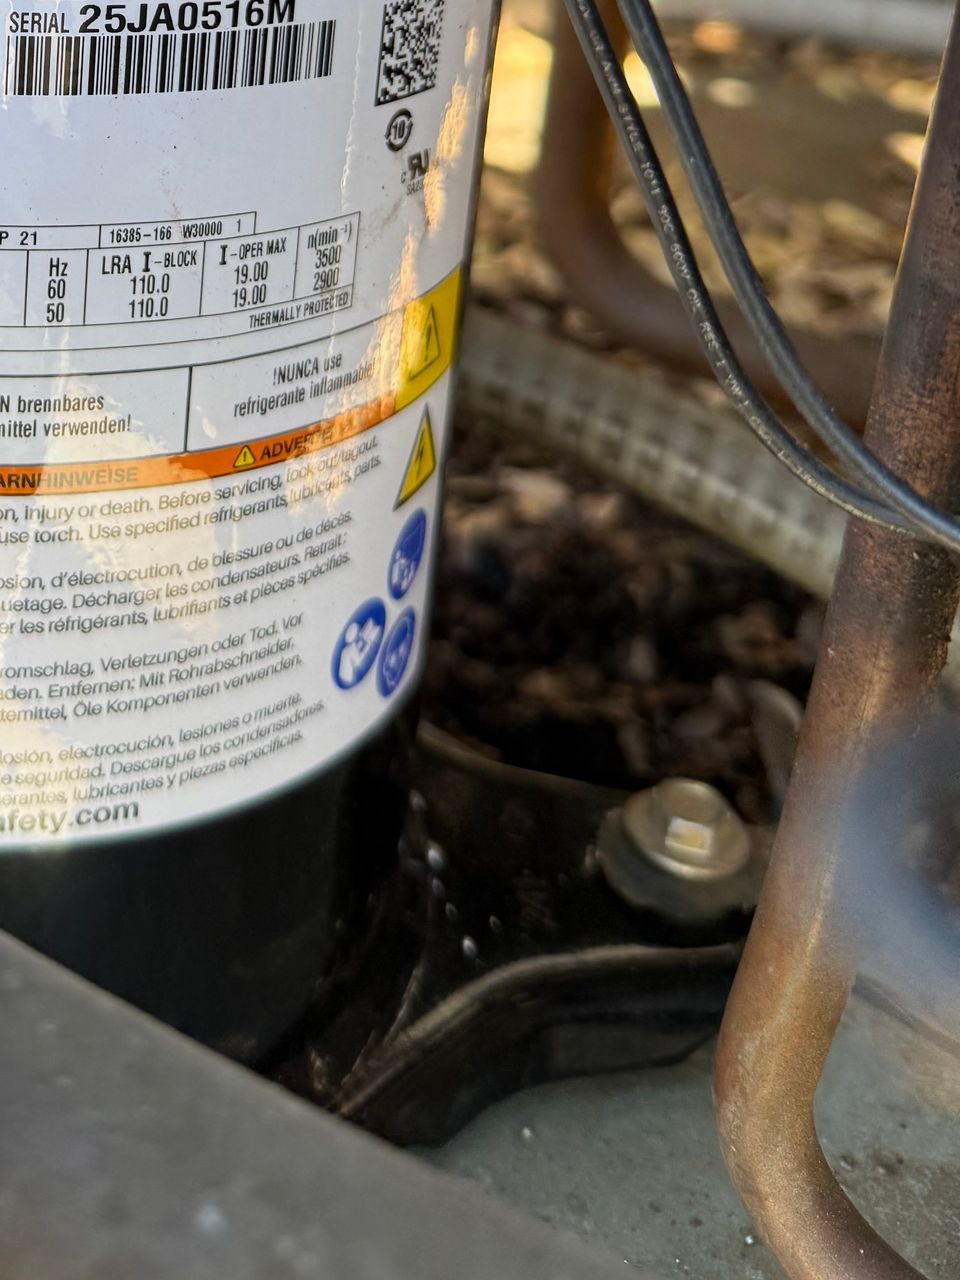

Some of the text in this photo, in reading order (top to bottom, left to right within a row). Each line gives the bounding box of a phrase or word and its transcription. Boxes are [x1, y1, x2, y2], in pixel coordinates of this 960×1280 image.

[9, 12, 69, 34] SERIAL
[20, 231, 37, 246] 21
[49, 257, 68, 277] Hz
[102, 237, 287, 275] LRA MAX
[130, 244, 341, 295] 110.0 19.00 3500
[47, 279, 66, 299] 60
[129, 266, 340, 319] 110.0 19.00 2900
[46, 302, 65, 323] 50
[249, 291, 348, 329] THERMALLY PROTECTED
[324, 353, 342, 370] use
[18, 394, 104, 413] brennbares
[234, 388, 305, 418] refrigerante
[44, 415, 131, 438] verwenden!
[24, 504, 74, 524] injury
[100, 493, 153, 516] death.
[158, 487, 211, 510] Before
[214, 472, 283, 501] servicing,
[34, 527, 84, 543] torch.
[90, 522, 121, 539] Use
[125, 511, 200, 539] specified
[204, 493, 288, 528] refrigerants,
[212, 538, 273, 567] blessure
[72, 587, 162, 610] Décharger
[153, 596, 231, 622] lubrifiants
[100, 643, 208, 672] Verletzungen
[212, 633, 246, 654] oder
[48, 678, 134, 699] Entfernen:
[179, 714, 240, 743] lesiones
